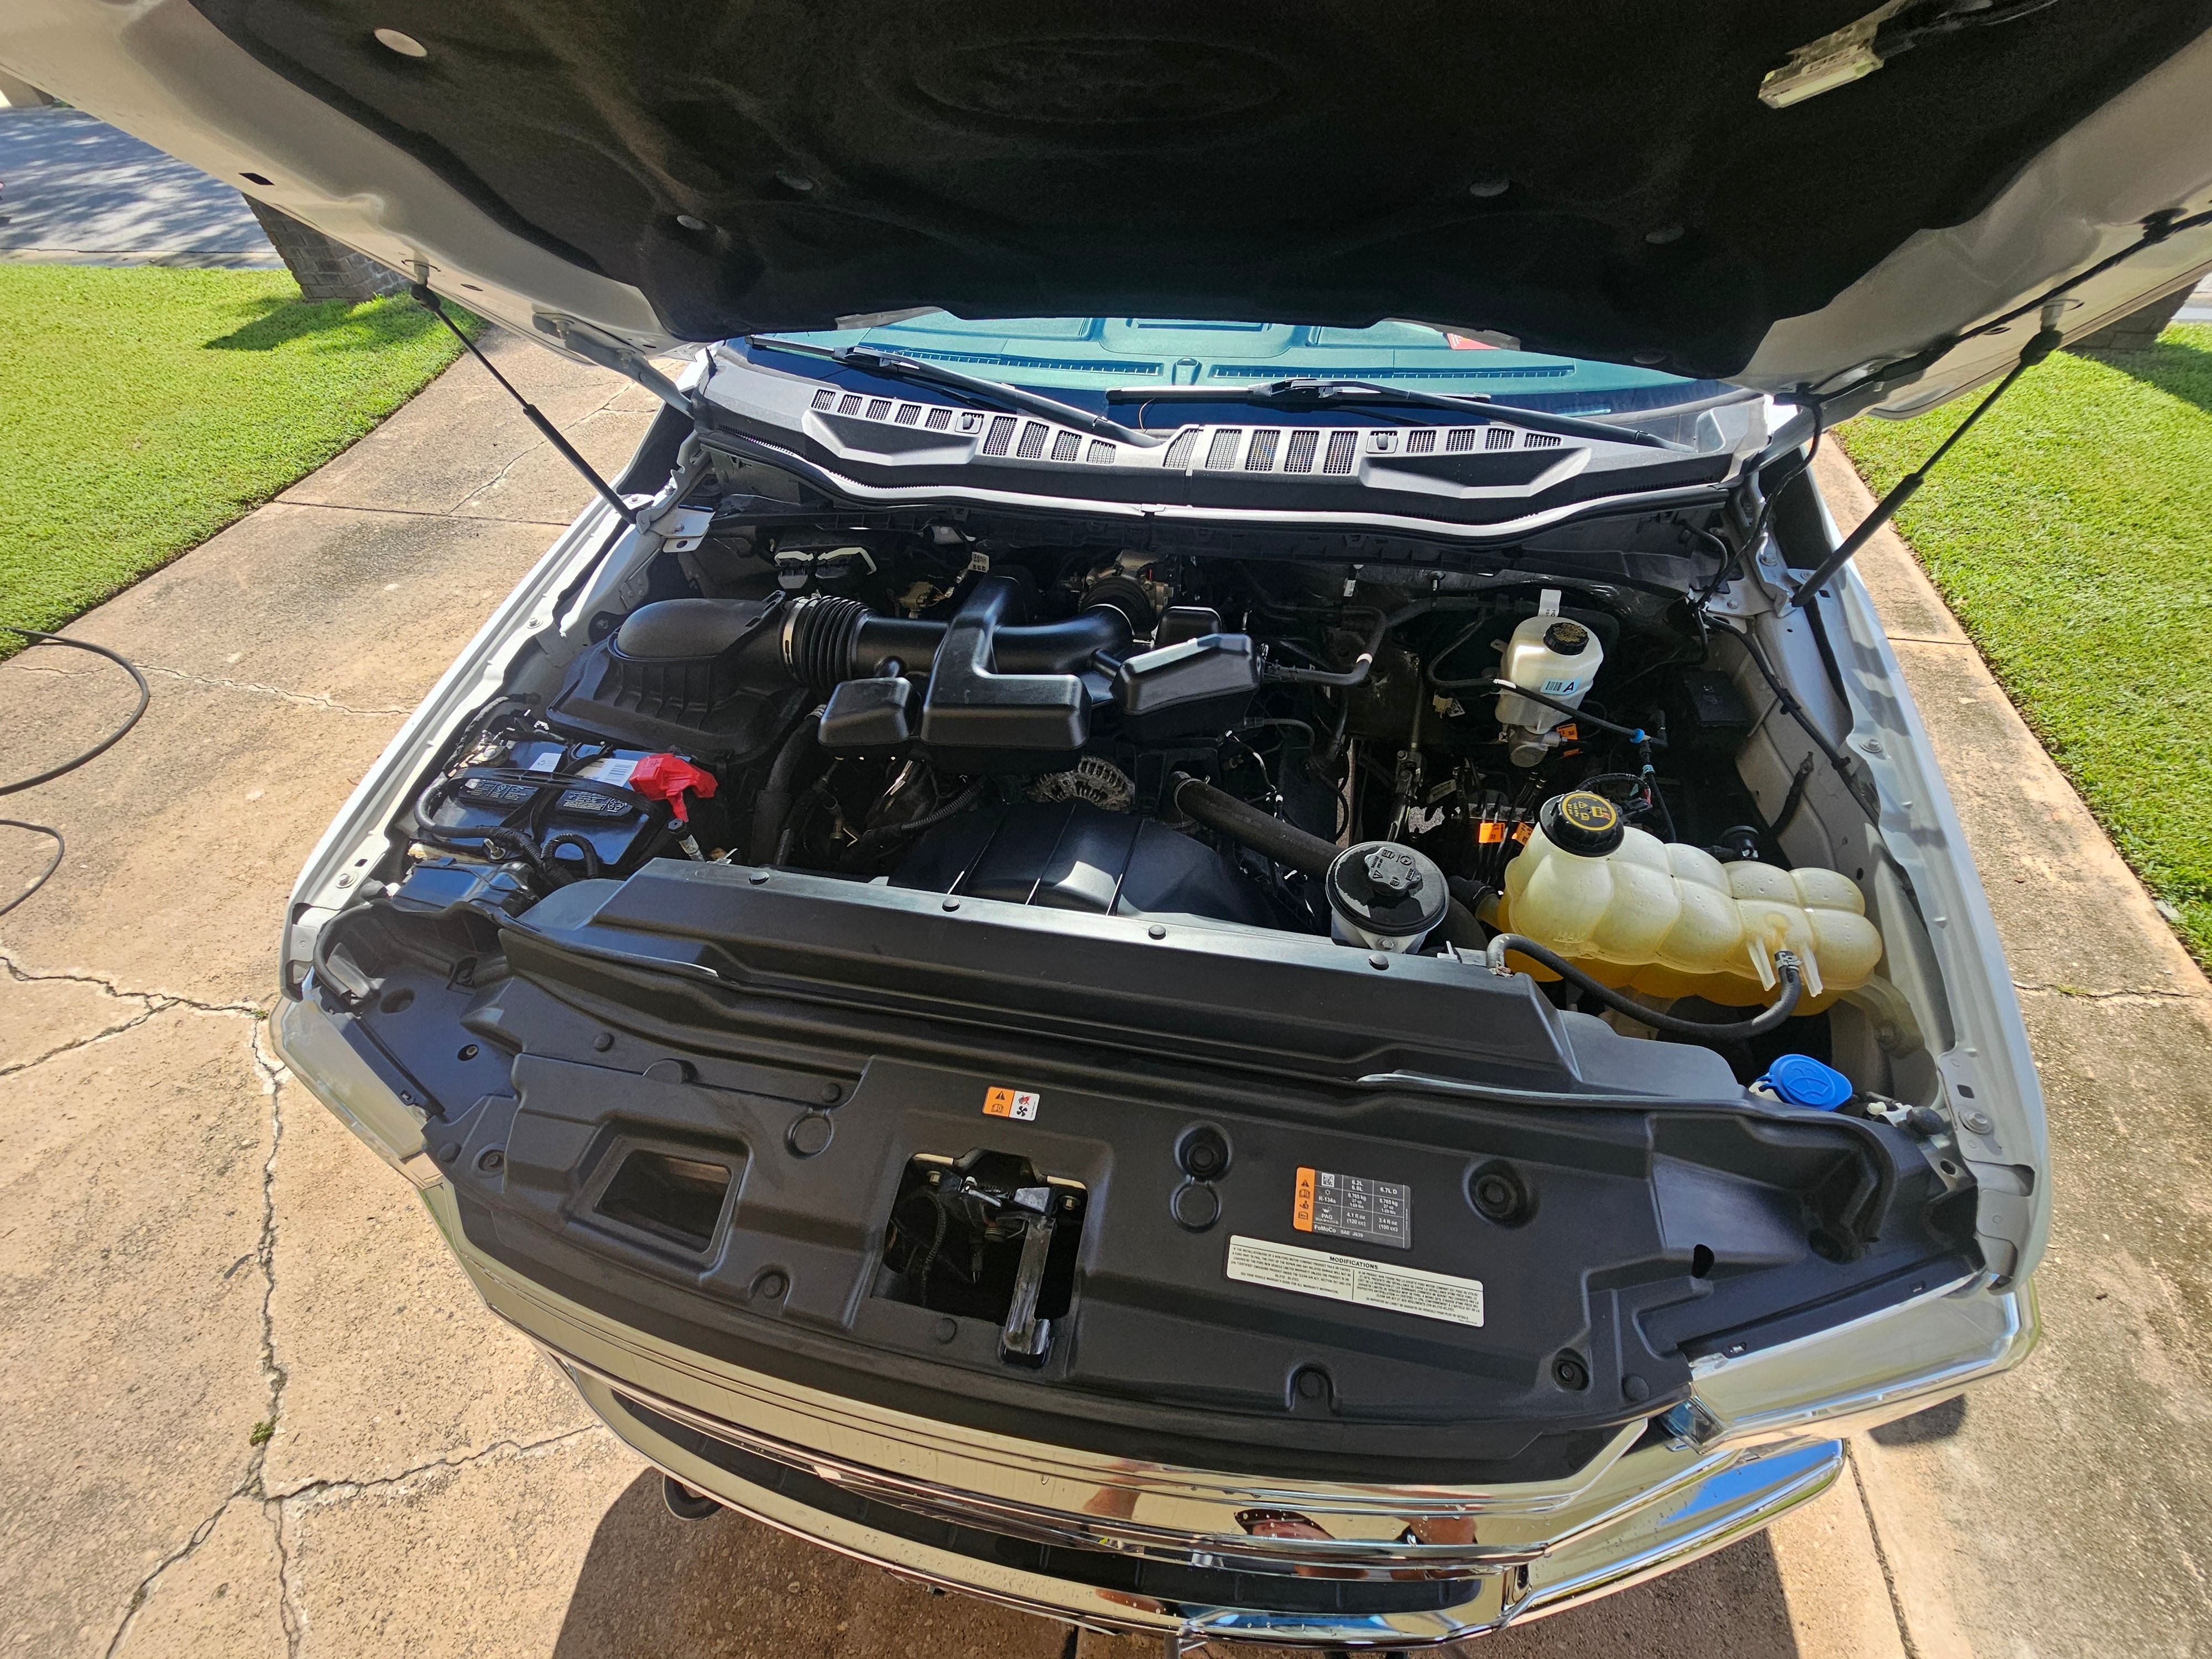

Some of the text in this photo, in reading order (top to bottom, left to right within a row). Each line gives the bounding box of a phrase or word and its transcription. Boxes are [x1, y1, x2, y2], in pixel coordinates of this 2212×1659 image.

[1562, 681, 1574, 692] A
[1314, 1224, 1336, 1233] FoMoCo
[1329, 1256, 1378, 1270] MODIFICATIONS
